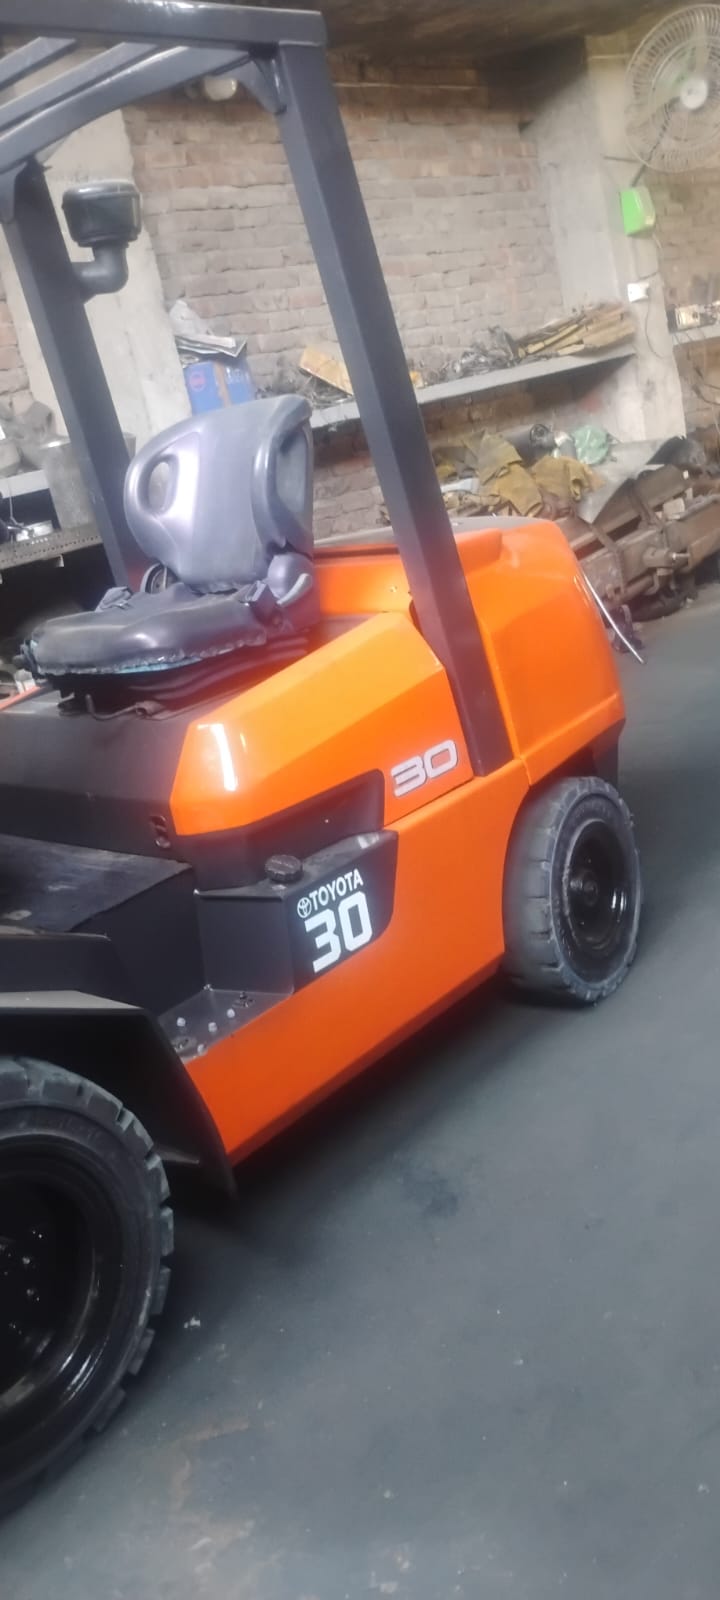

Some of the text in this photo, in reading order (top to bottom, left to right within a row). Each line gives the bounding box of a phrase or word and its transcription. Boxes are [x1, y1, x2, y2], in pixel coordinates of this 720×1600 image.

[390, 739, 458, 798] 30
[309, 868, 364, 911] TOYOTA
[304, 891, 373, 973] 30
